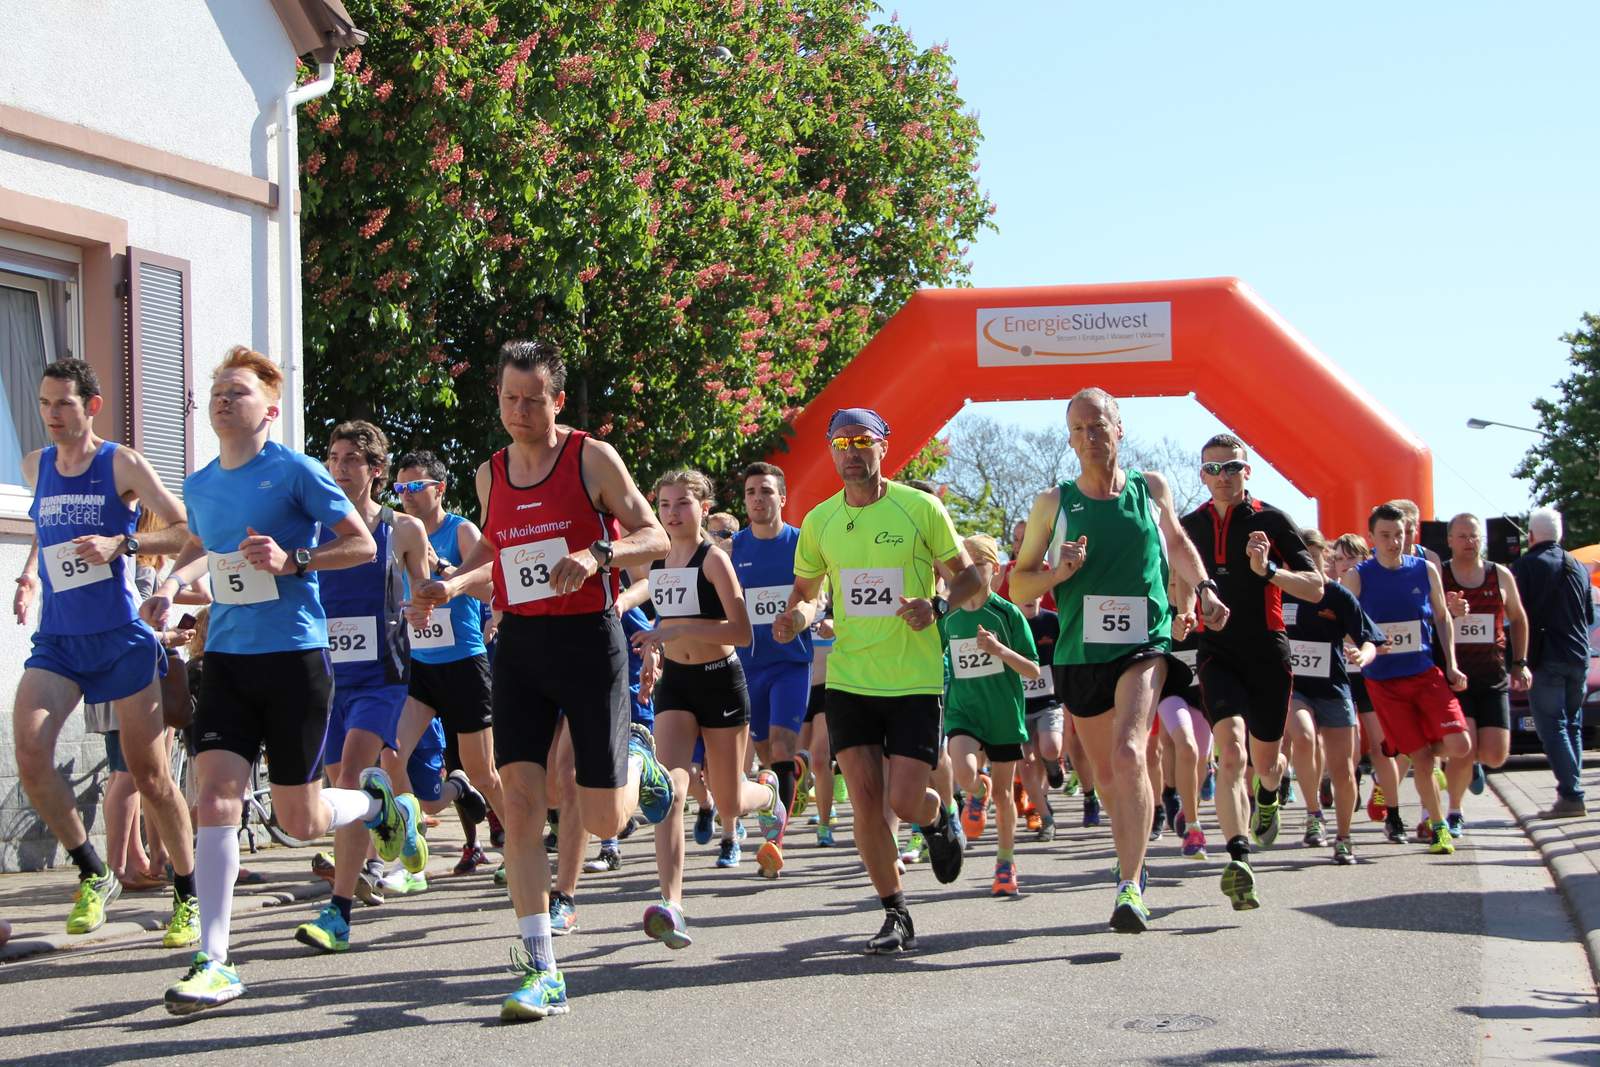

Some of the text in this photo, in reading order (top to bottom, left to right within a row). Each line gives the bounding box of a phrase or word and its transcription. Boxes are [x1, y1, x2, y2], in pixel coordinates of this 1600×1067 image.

[1004, 312, 1148, 336] EnergieSüdwest
[496, 520, 572, 542] TV Maikammer
[62, 558, 89, 577] 95
[519, 563, 550, 588] 83
[228, 574, 244, 592] 5
[654, 587, 687, 605] 517
[850, 587, 893, 606] 524
[755, 600, 787, 616] 603
[413, 624, 444, 639] 569
[1102, 614, 1131, 632] 55
[1460, 624, 1487, 636] 561
[328, 634, 367, 652] 592
[705, 660, 726, 671] NIKE
[958, 652, 993, 669] 522
[1291, 654, 1322, 668] 537
[1023, 678, 1046, 691] 528
